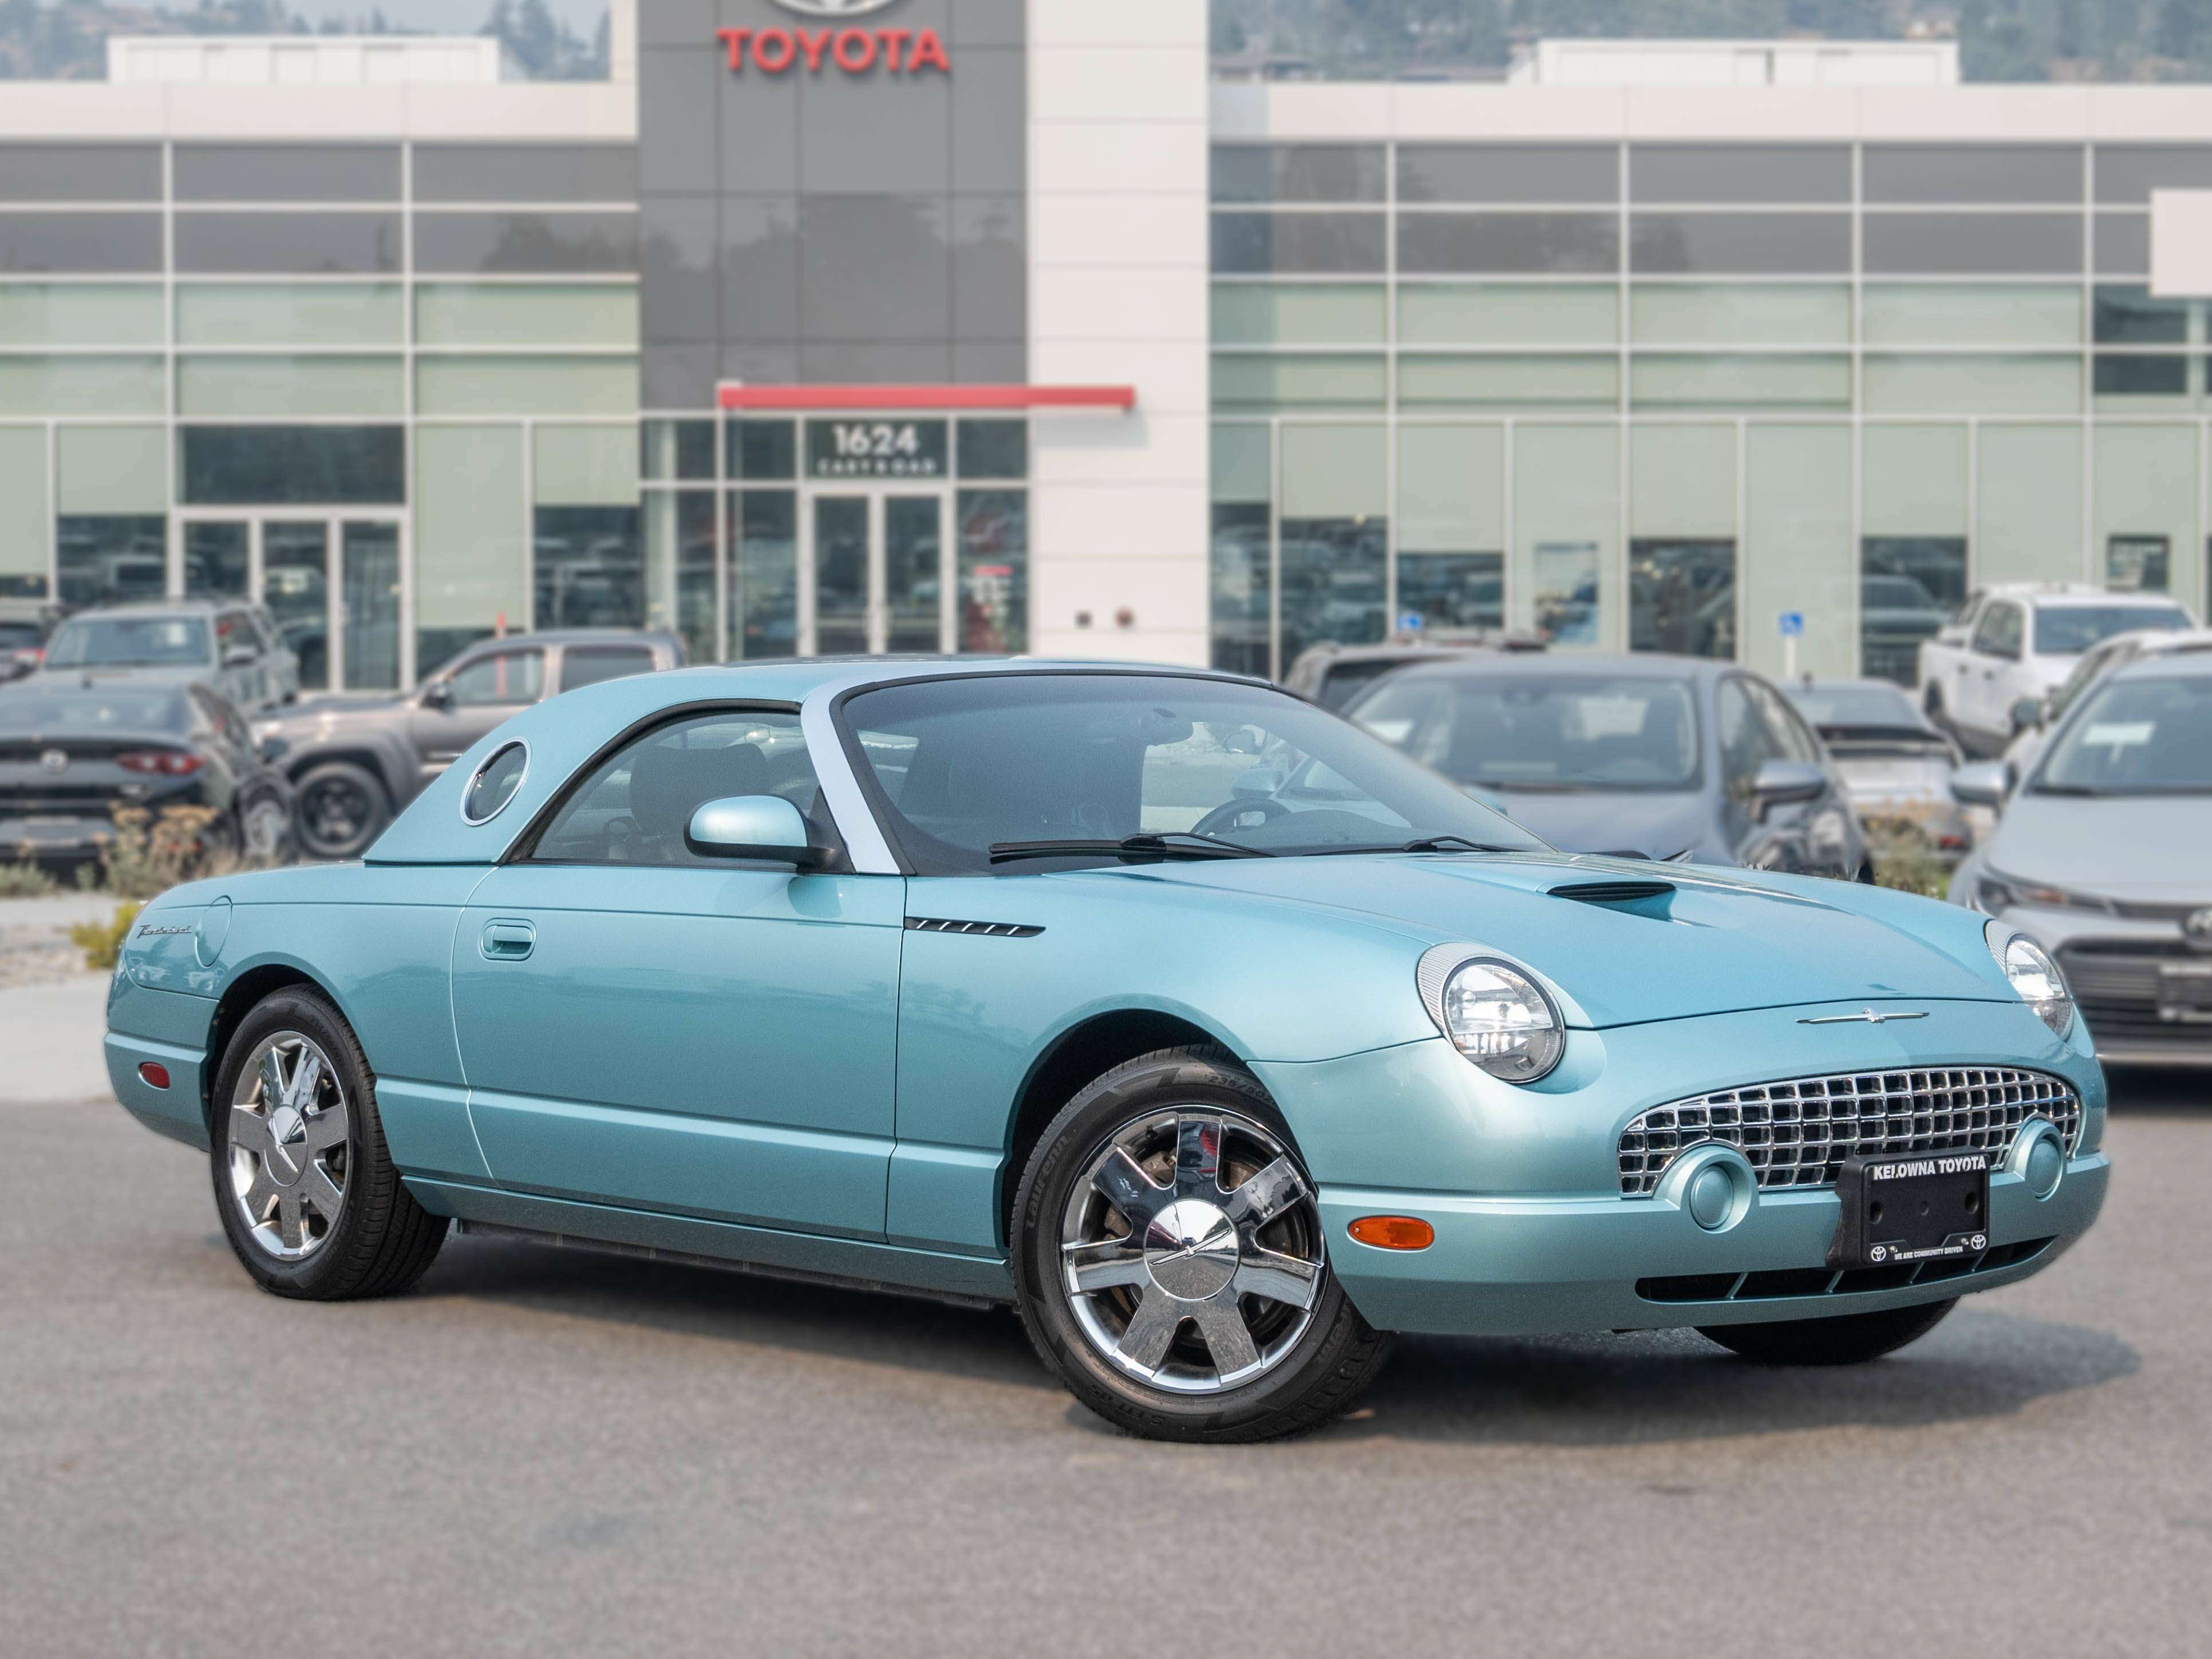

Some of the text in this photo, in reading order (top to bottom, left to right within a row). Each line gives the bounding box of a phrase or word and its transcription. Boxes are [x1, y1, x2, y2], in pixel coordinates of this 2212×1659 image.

[716, 28, 950, 72] TOYOTA
[832, 424, 920, 456] 1624
[1874, 1155, 1986, 1180] KELOWNA TOYOTA
[1894, 1246, 1964, 1261] WE ARE COMMUNITY DRIVEN
